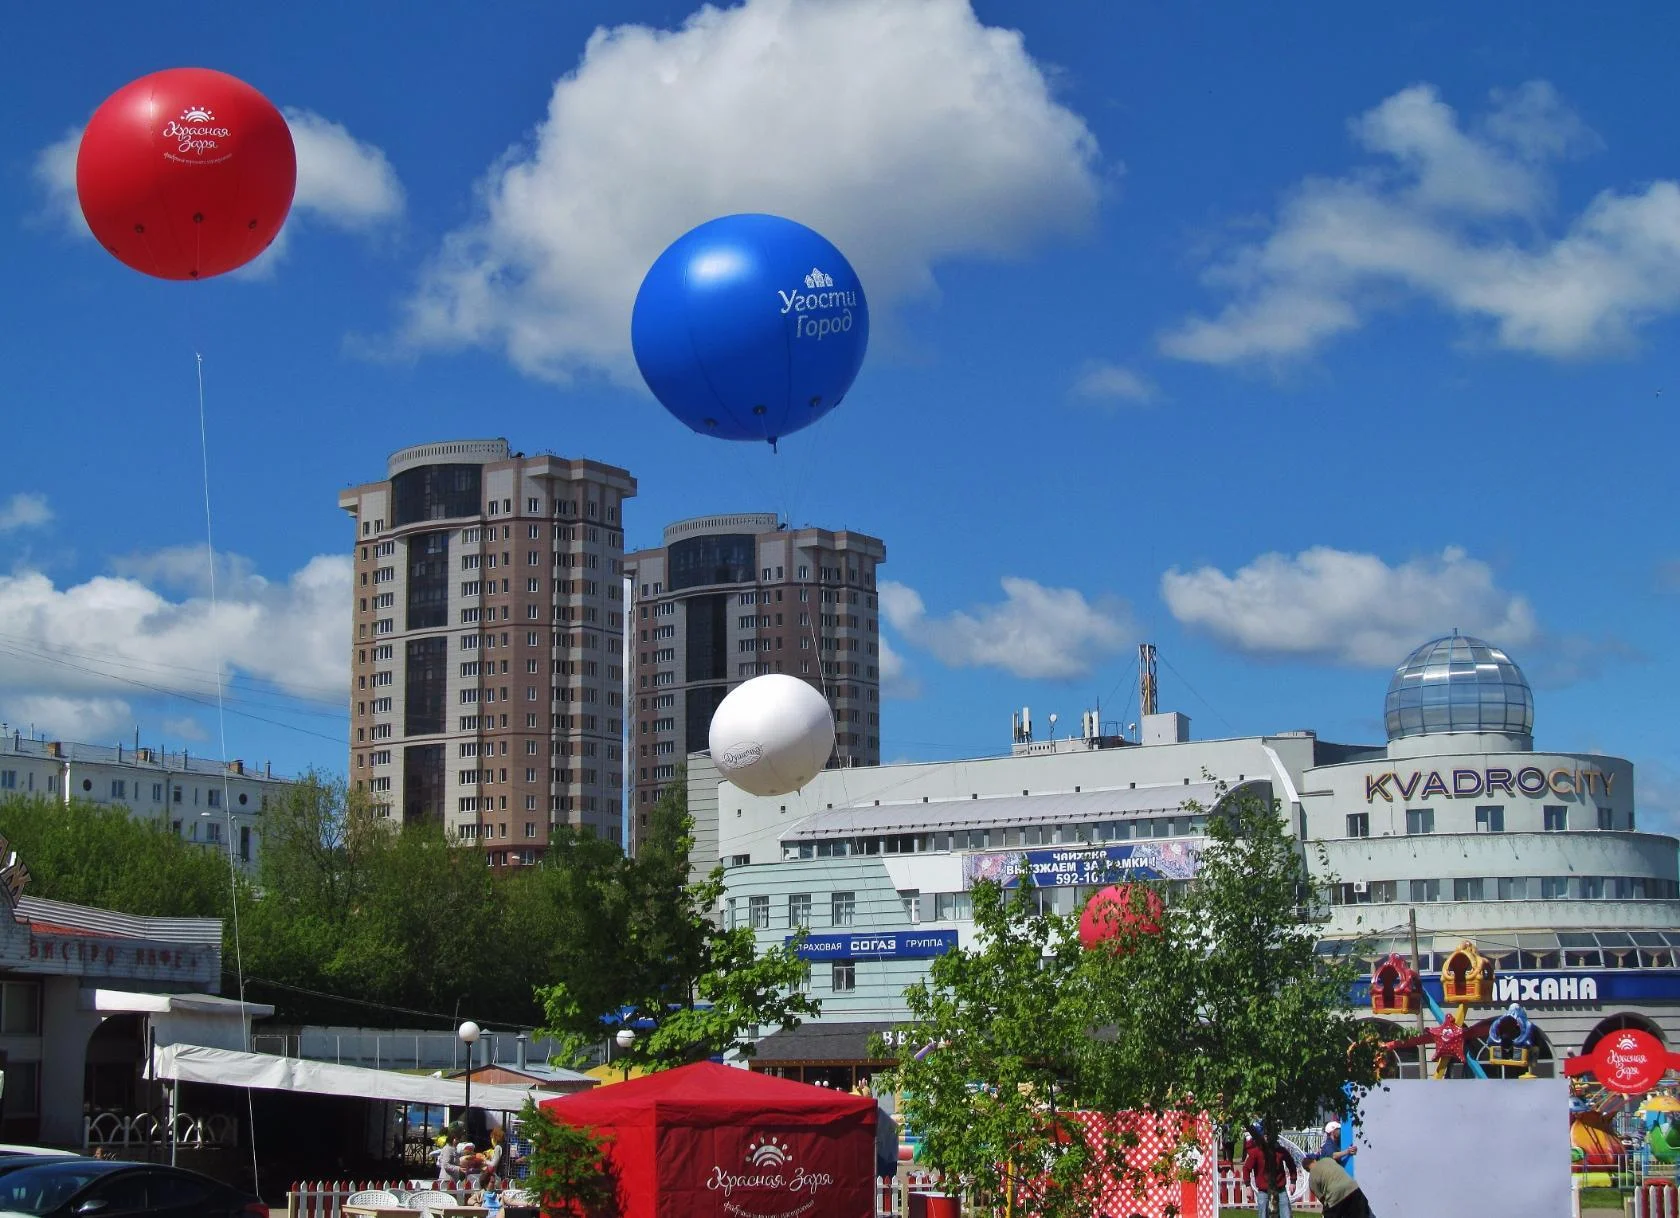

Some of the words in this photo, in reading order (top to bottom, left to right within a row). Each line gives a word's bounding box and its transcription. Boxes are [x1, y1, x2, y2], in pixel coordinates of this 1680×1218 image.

[163, 121, 231, 141] Красная
[179, 135, 218, 155] Заря
[778, 289, 857, 314] Угости
[796, 308, 852, 340] Город
[1365, 766, 1615, 802] KVADROCITY
[1083, 860, 1099, 871] ЗА
[794, 943, 842, 952] ТРАХОВАЯ
[851, 940, 897, 951] СОГАЗ
[905, 938, 943, 949] ГРУППА
[707, 1166, 787, 1198] Красная
[789, 1167, 834, 1195] Заря
